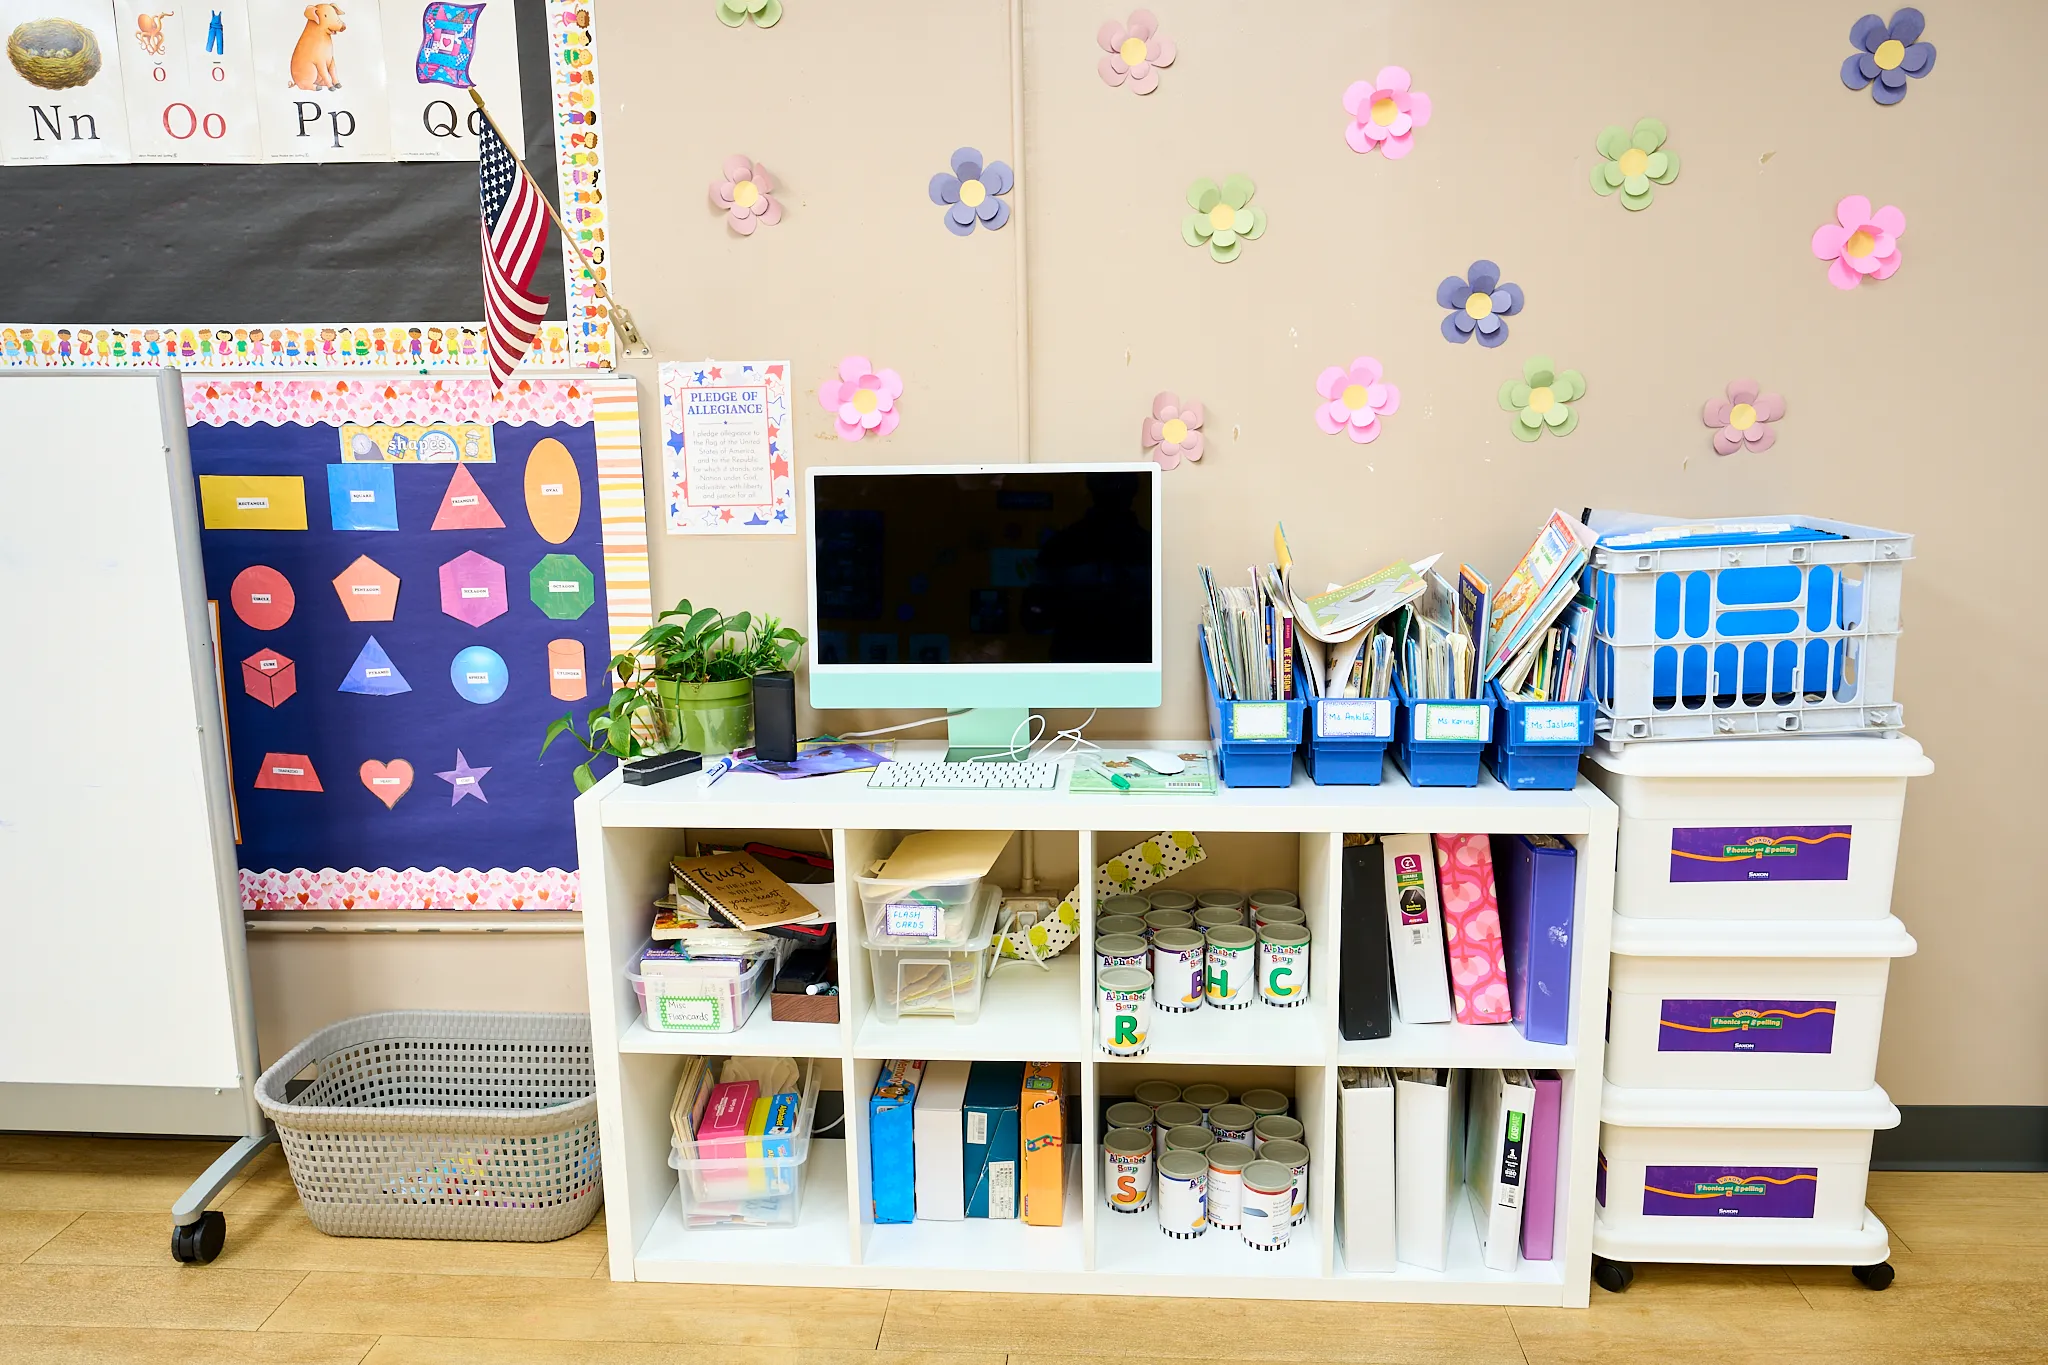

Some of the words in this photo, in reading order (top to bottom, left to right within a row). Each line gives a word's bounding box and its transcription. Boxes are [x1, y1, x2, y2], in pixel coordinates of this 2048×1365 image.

[29, 104, 101, 141] Nn
[163, 102, 227, 140] Oo
[293, 101, 356, 148] Pp
[690, 391, 738, 402] PLEDGE
[742, 391, 758, 402] OF
[687, 404, 763, 415] ALLEGIANCE
[697, 430, 718, 438] pledge
[388, 436, 446, 451] shapes
[705, 438, 718, 447] flag
[1284, 647, 1292, 657] WE
[1284, 659, 1292, 672] CAN
[1284, 674, 1292, 692] SIGN!
[1546, 719, 1575, 729] Jasleen
[1725, 846, 1755, 854] Phonics
[1765, 846, 1796, 854] Spelling
[692, 861, 755, 883] Trust
[739, 879, 762, 888] LORD
[728, 888, 749, 896] WITH
[728, 896, 753, 910] your
[893, 911, 921, 919] FLASH
[895, 921, 924, 929] CARDS
[1264, 944, 1302, 954] Alphabet
[1103, 957, 1143, 967] Alphabet
[1209, 954, 1227, 966] Soup
[1271, 954, 1293, 964] Soup
[1207, 964, 1229, 998] H
[1269, 967, 1293, 996] C
[1105, 992, 1147, 1001] Alphabet
[668, 1001, 686, 1009] Misc
[1115, 1002, 1138, 1012] Soup
[668, 1012, 709, 1022] Flashcards
[1750, 1019, 1781, 1027] Spelling
[1115, 1015, 1138, 1045] R
[776, 1105, 789, 1127] Alphabet
[1109, 1153, 1147, 1165] Alphabet
[1117, 1164, 1139, 1174] Soup
[1117, 1175, 1137, 1203] S
[1734, 1185, 1764, 1193] Spelling
